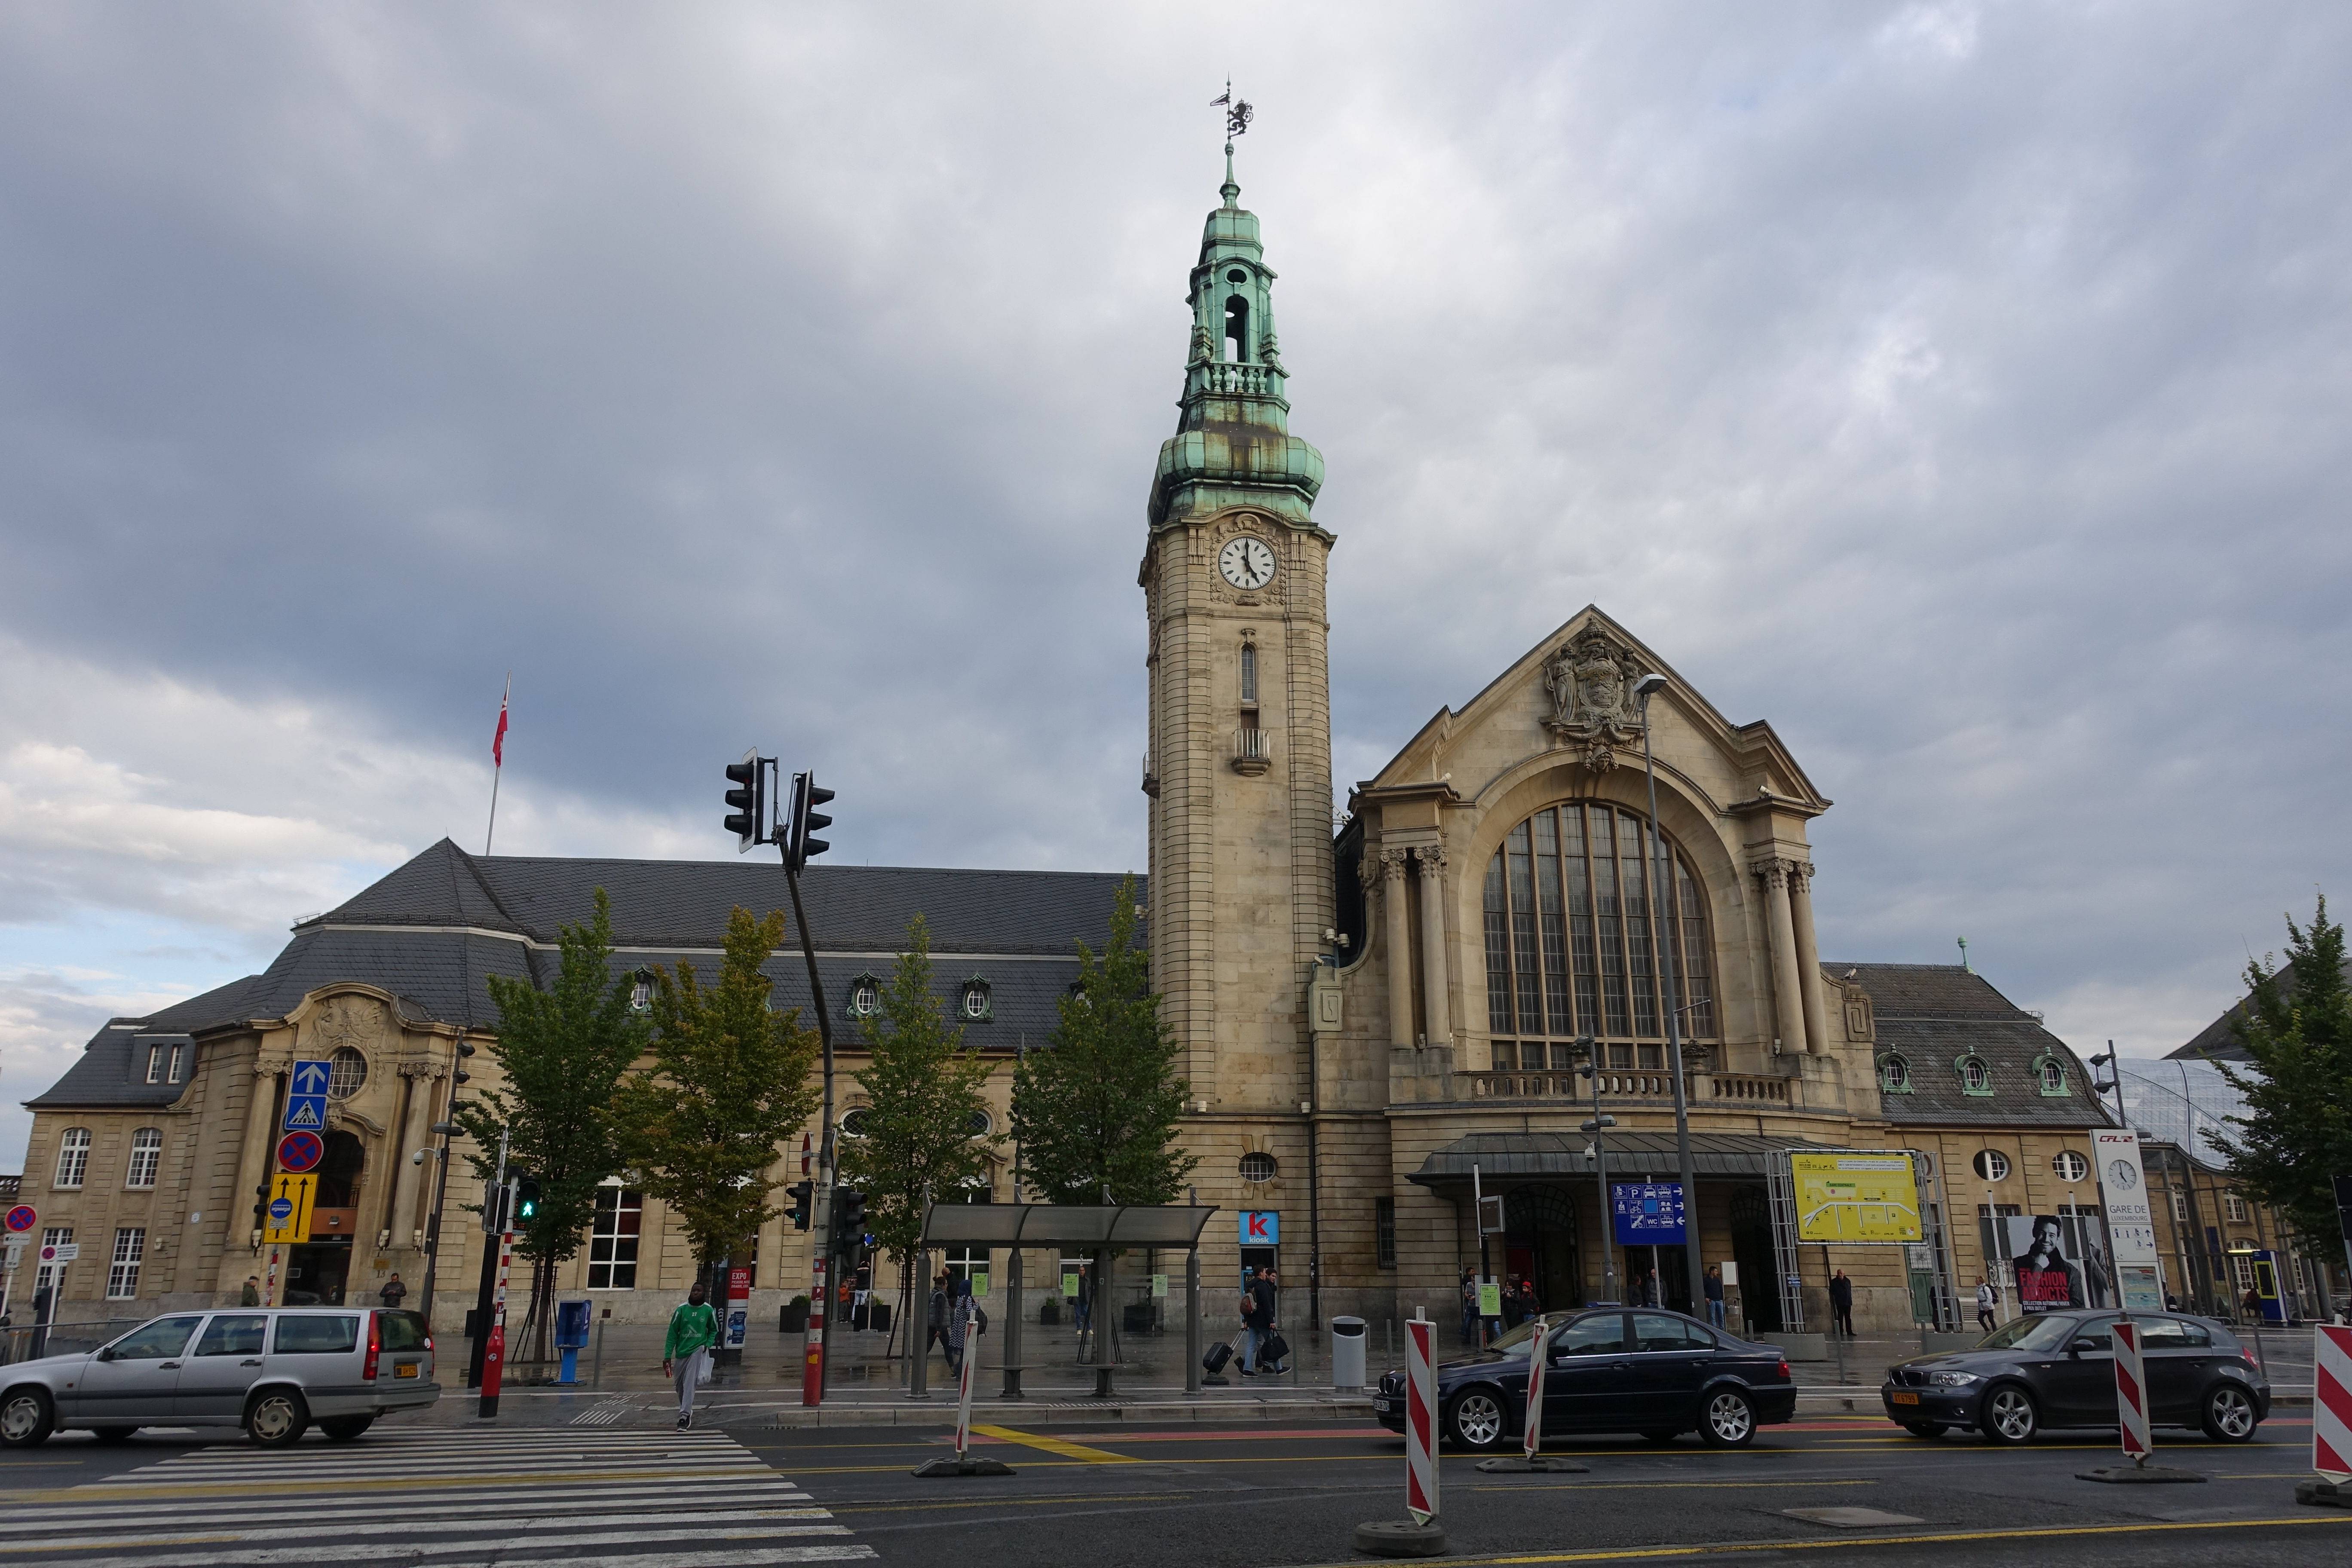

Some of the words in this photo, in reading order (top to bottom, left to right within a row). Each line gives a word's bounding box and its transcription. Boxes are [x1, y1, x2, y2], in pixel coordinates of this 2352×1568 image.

[1632, 1189, 1638, 1198] P
[2110, 1205, 2132, 1213] GARE
[2135, 1205, 2147, 1213] DE
[1249, 1213, 1268, 1236] k
[376, 1270, 386, 1278] 13
